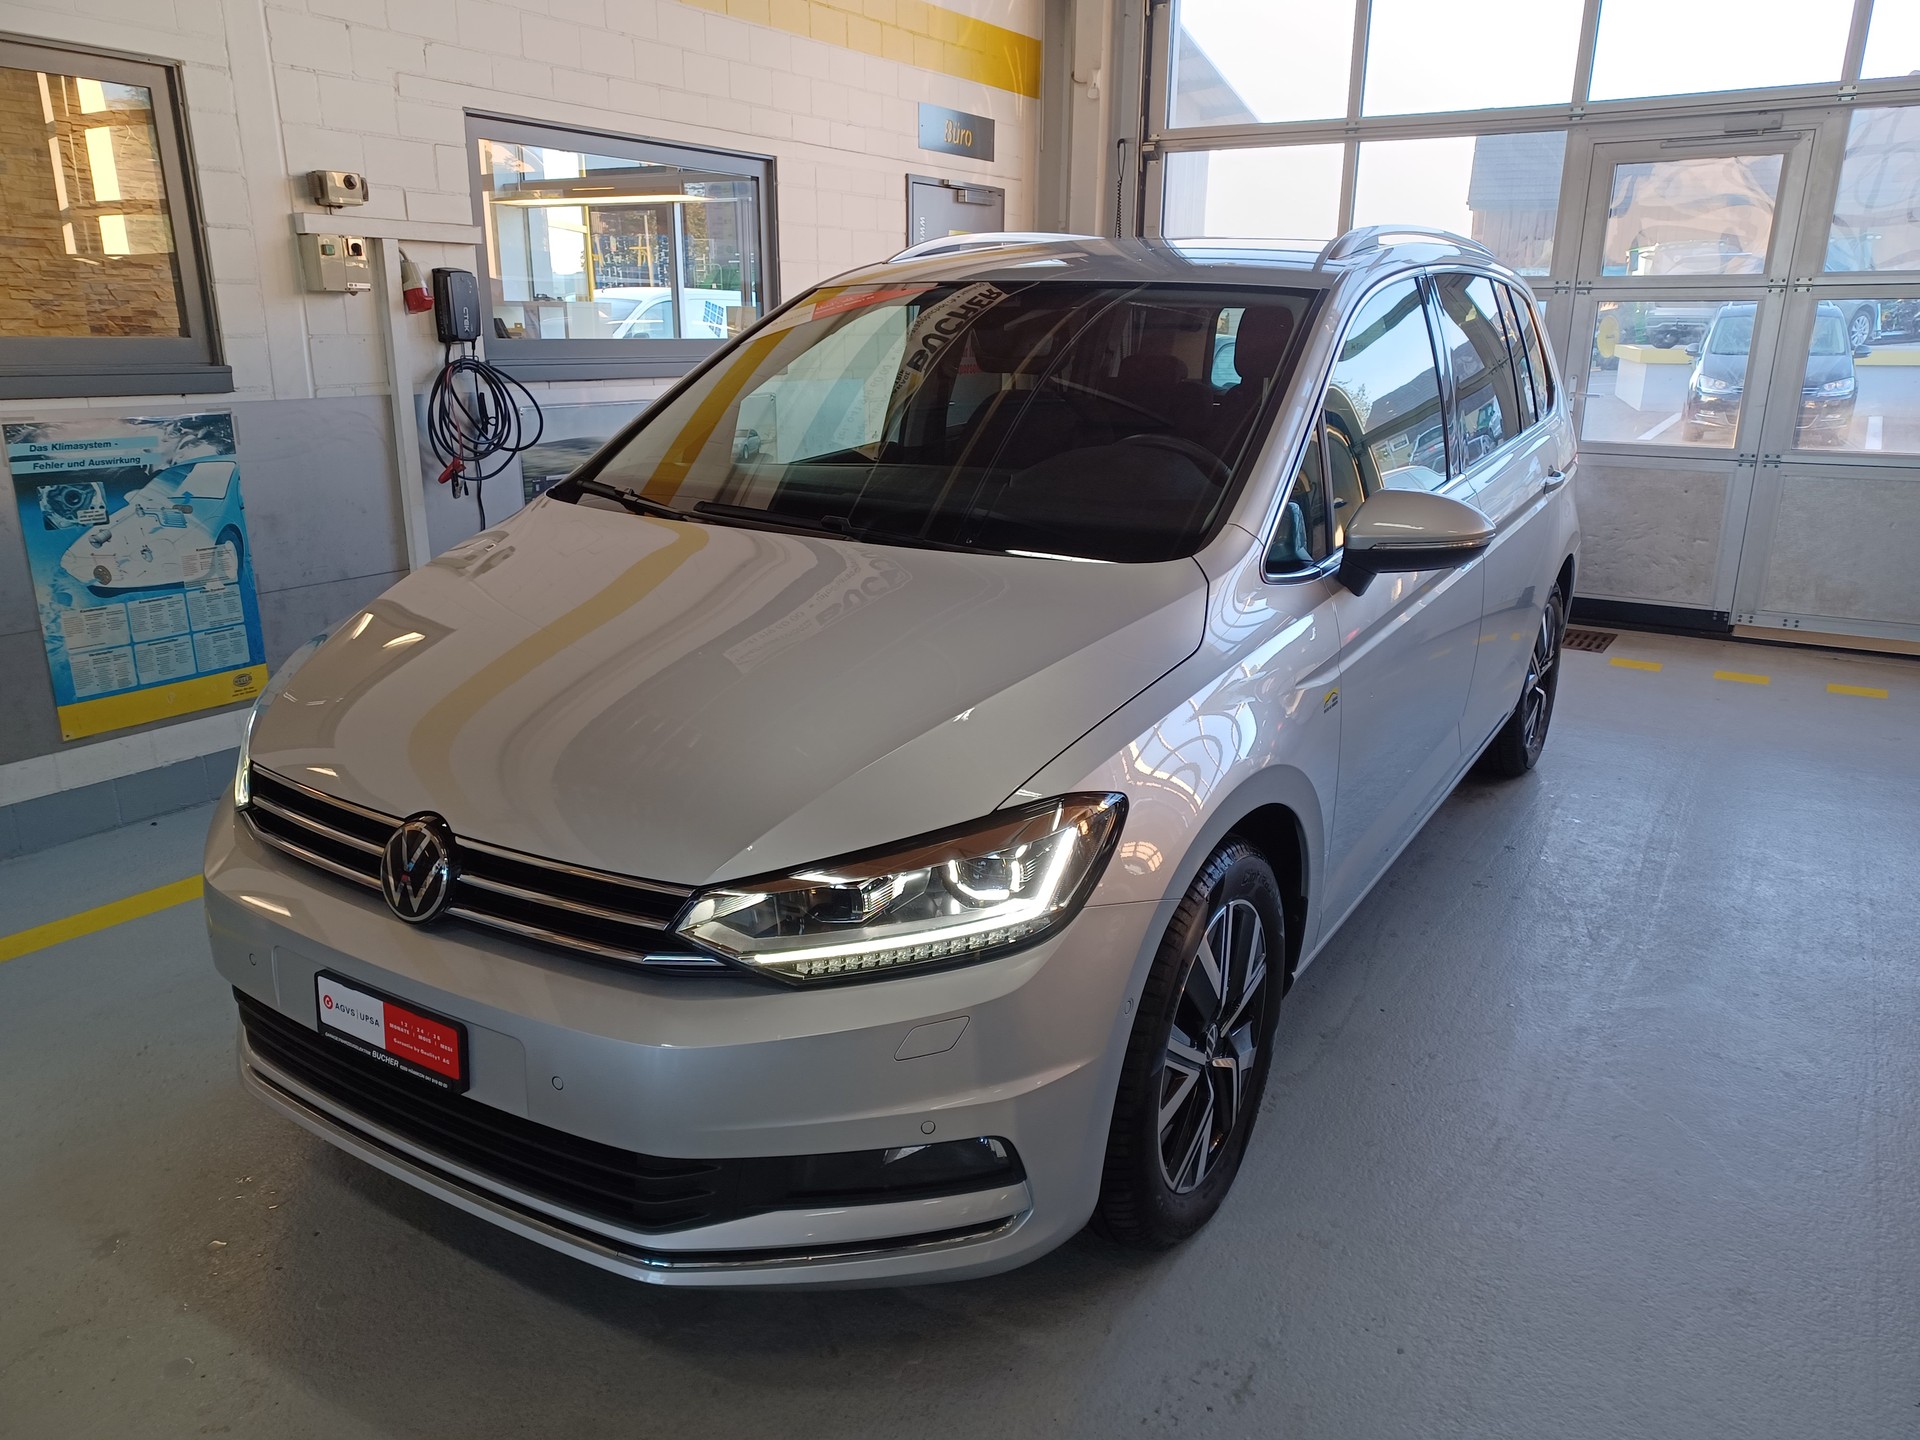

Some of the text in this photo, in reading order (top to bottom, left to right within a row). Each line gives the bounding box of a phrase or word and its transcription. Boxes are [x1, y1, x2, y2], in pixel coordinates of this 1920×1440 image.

[944, 119, 973, 147] Büro
[51, 441, 112, 451] Klimasystem
[33, 461, 64, 470] Fehler
[88, 456, 141, 466] Auswirkung
[335, 1003, 355, 1017] AGVS
[360, 1012, 380, 1027] UPSA
[389, 1023, 410, 1035] MONATE
[372, 1050, 399, 1067] BUCHER
